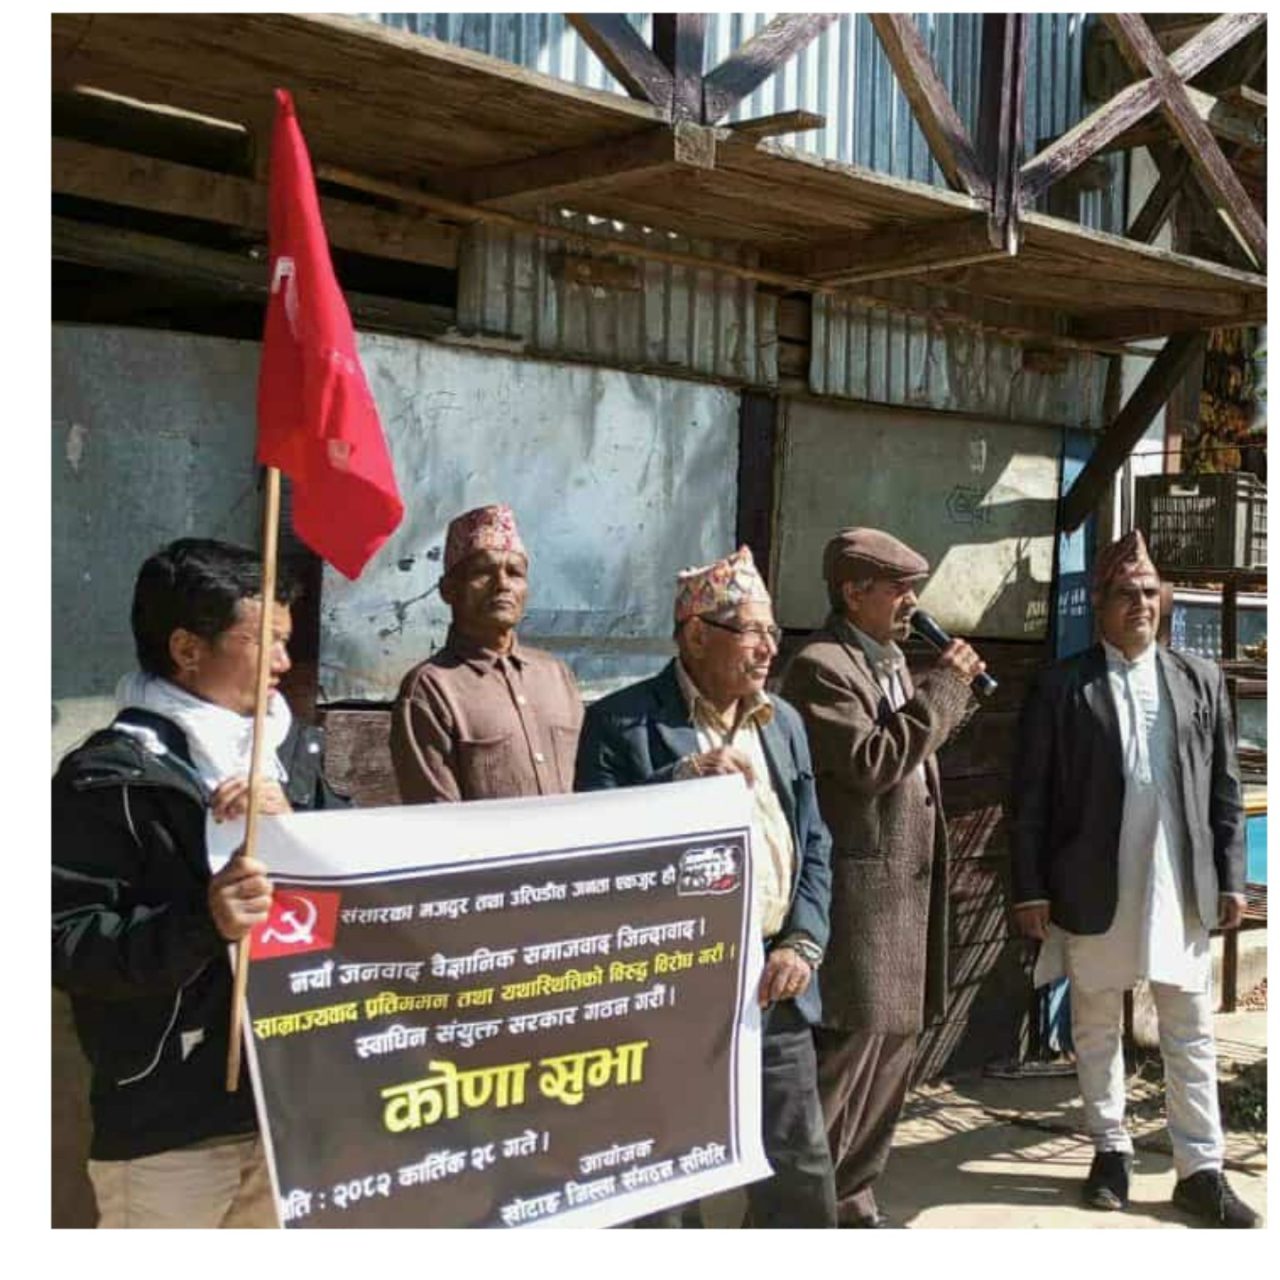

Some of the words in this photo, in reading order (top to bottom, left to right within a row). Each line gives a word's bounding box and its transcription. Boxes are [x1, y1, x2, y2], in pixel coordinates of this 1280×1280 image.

[339, 962, 424, 985] जनवाद
[431, 948, 518, 981] वैज्ञानिक
[523, 933, 613, 966] समाजवाद
[617, 920, 697, 951] जिन्दावाद
[457, 987, 496, 1009] तथा
[509, 1006, 578, 1035] सरकार
[584, 996, 631, 1021] गठन
[578, 1138, 656, 1174] आयोजक
[677, 1141, 727, 1174] समिति
[333, 1172, 392, 1209] २०८२
[471, 1142, 496, 1170] २८
